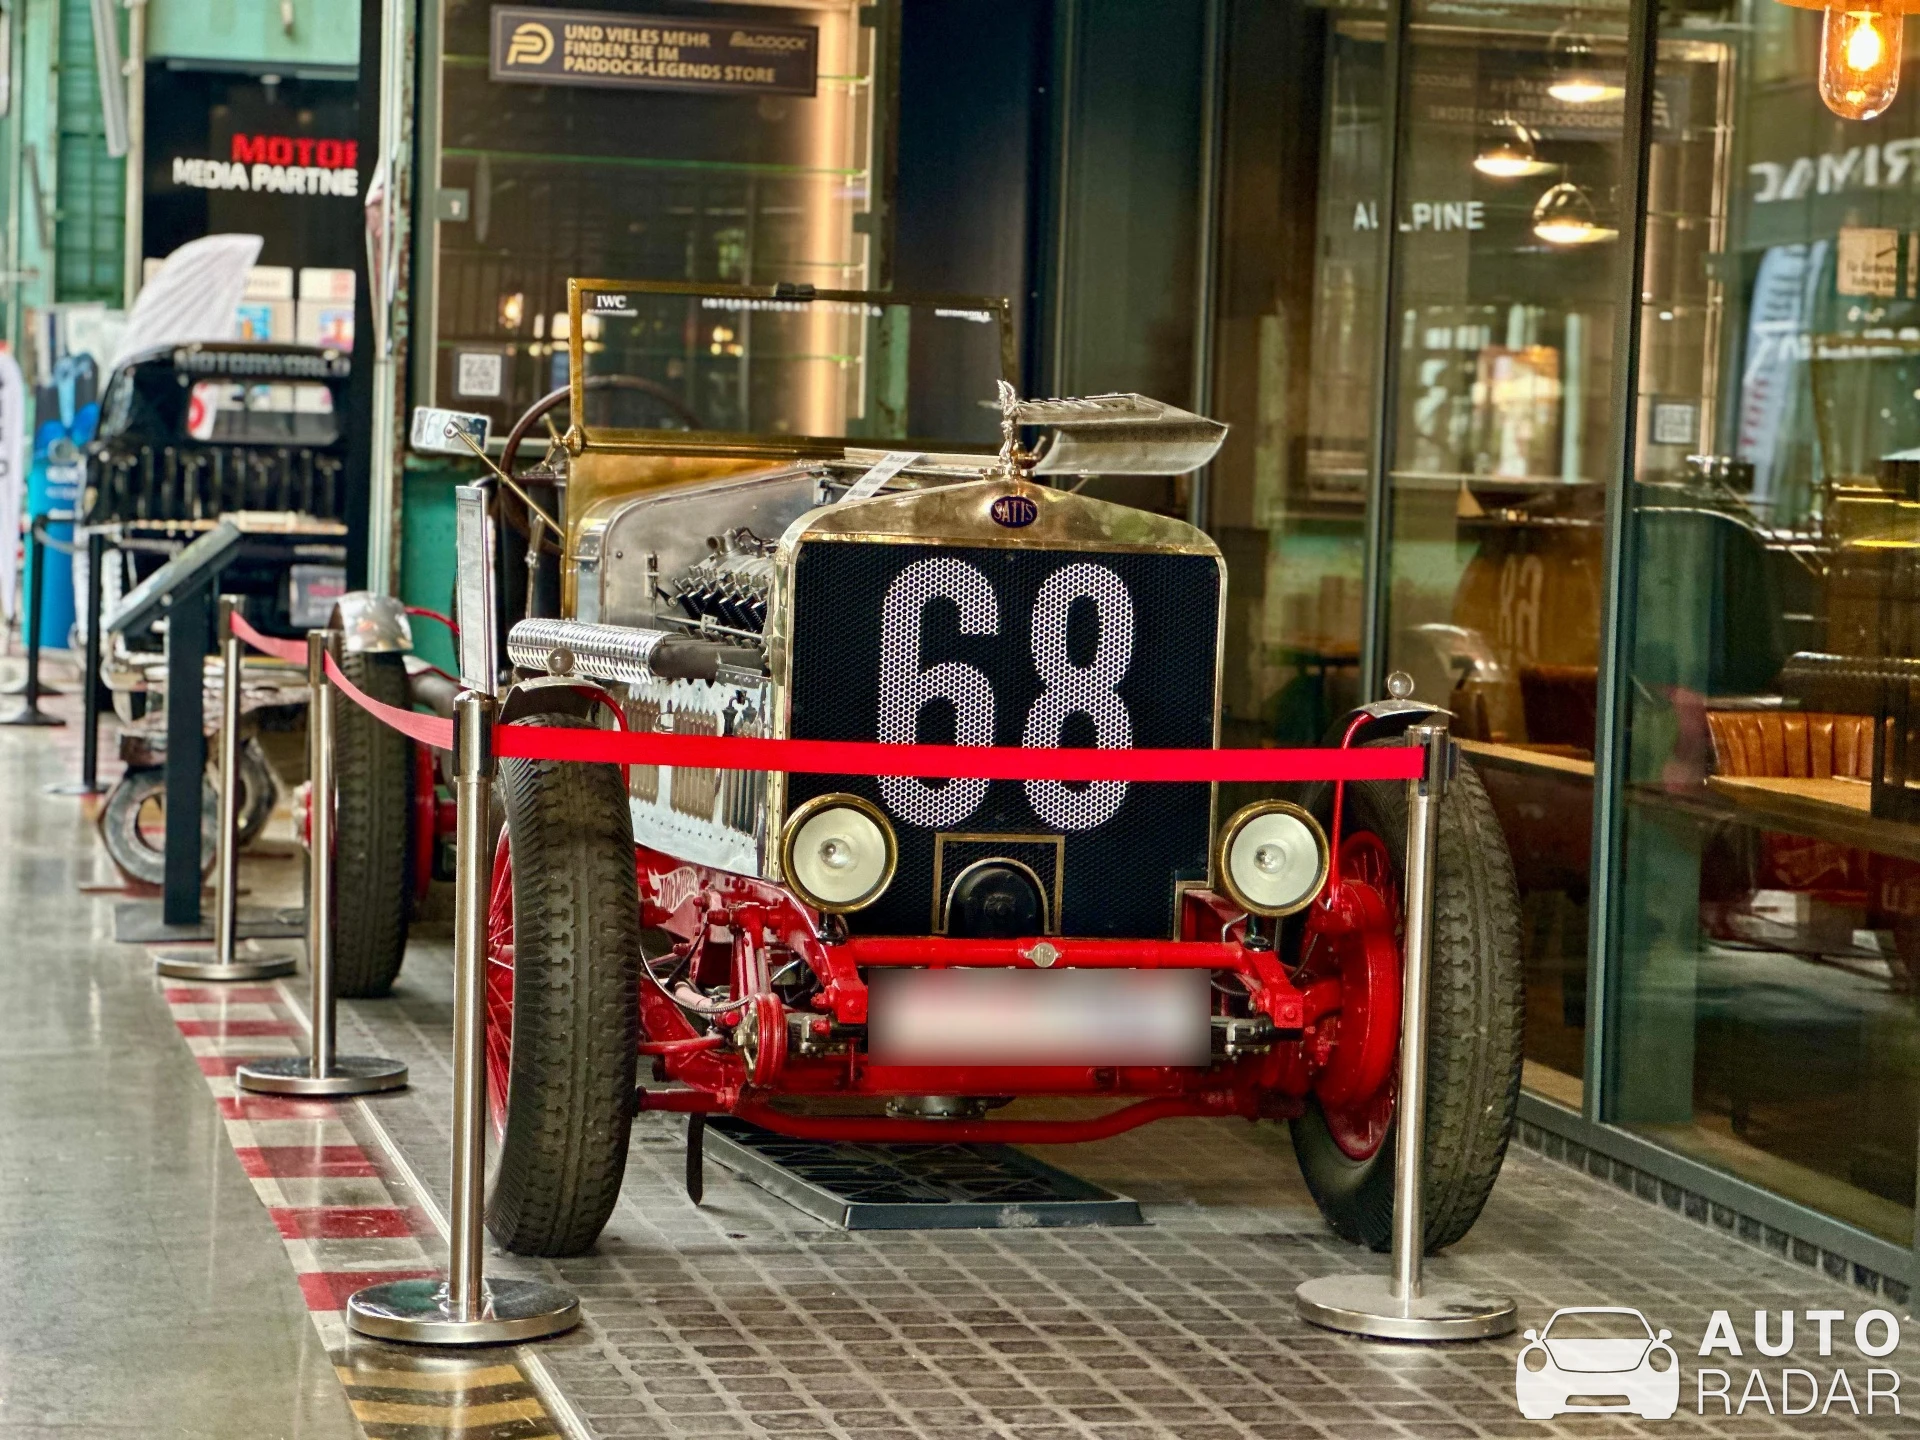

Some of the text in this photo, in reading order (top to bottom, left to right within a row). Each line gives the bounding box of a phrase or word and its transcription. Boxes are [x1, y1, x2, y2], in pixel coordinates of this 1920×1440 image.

[564, 24, 710, 48] UND VIELES MEHR
[564, 40, 680, 62] FINDEN SIE IM
[563, 56, 776, 83] PADDOCK-LEGENDS STORE
[172, 157, 250, 192] MEDIA
[596, 295, 627, 309] IWC
[993, 500, 1034, 523] SATIS
[876, 557, 1135, 831] 68
